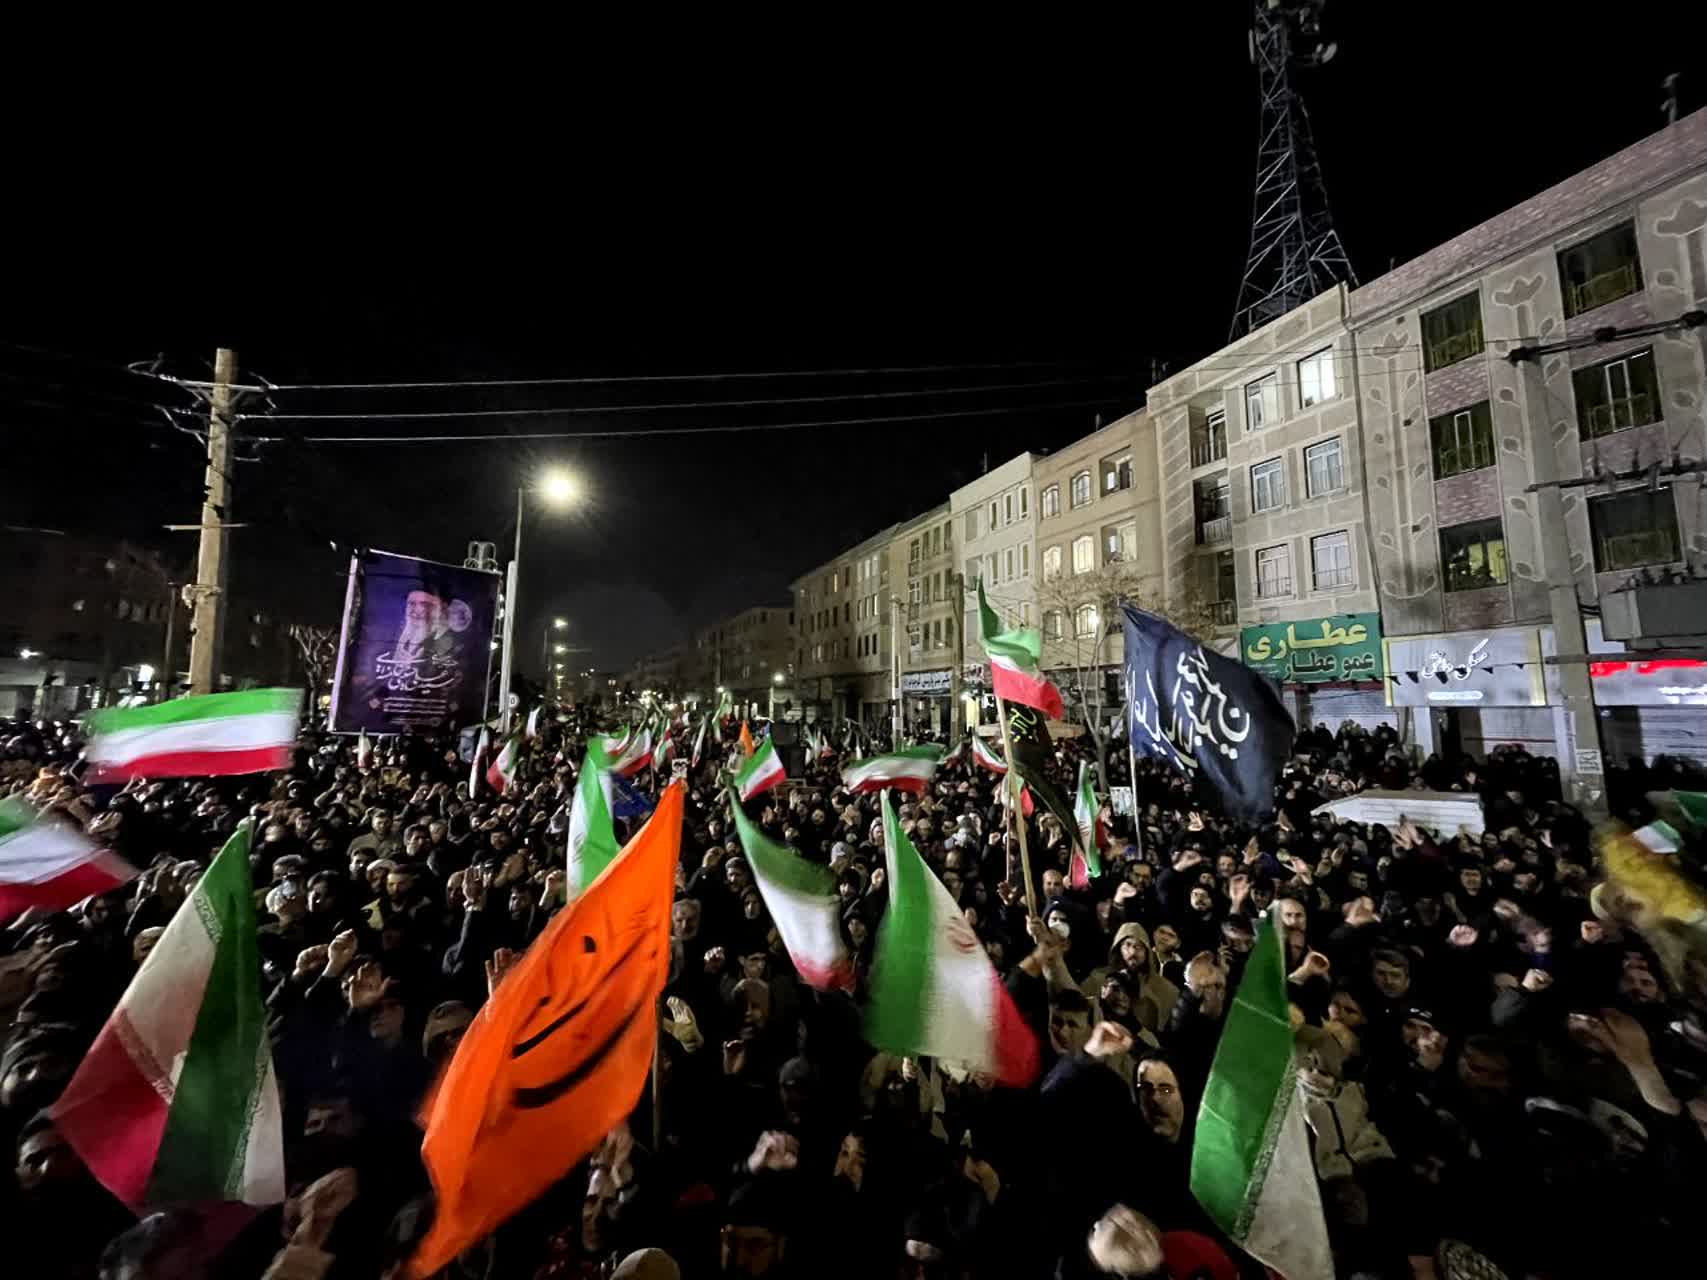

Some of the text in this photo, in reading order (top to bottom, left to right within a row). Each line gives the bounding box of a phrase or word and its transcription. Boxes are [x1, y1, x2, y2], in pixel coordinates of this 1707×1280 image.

[1247, 619, 1368, 661] عطاری
[1283, 649, 1337, 681] عطار
[1341, 652, 1376, 681] عمو
